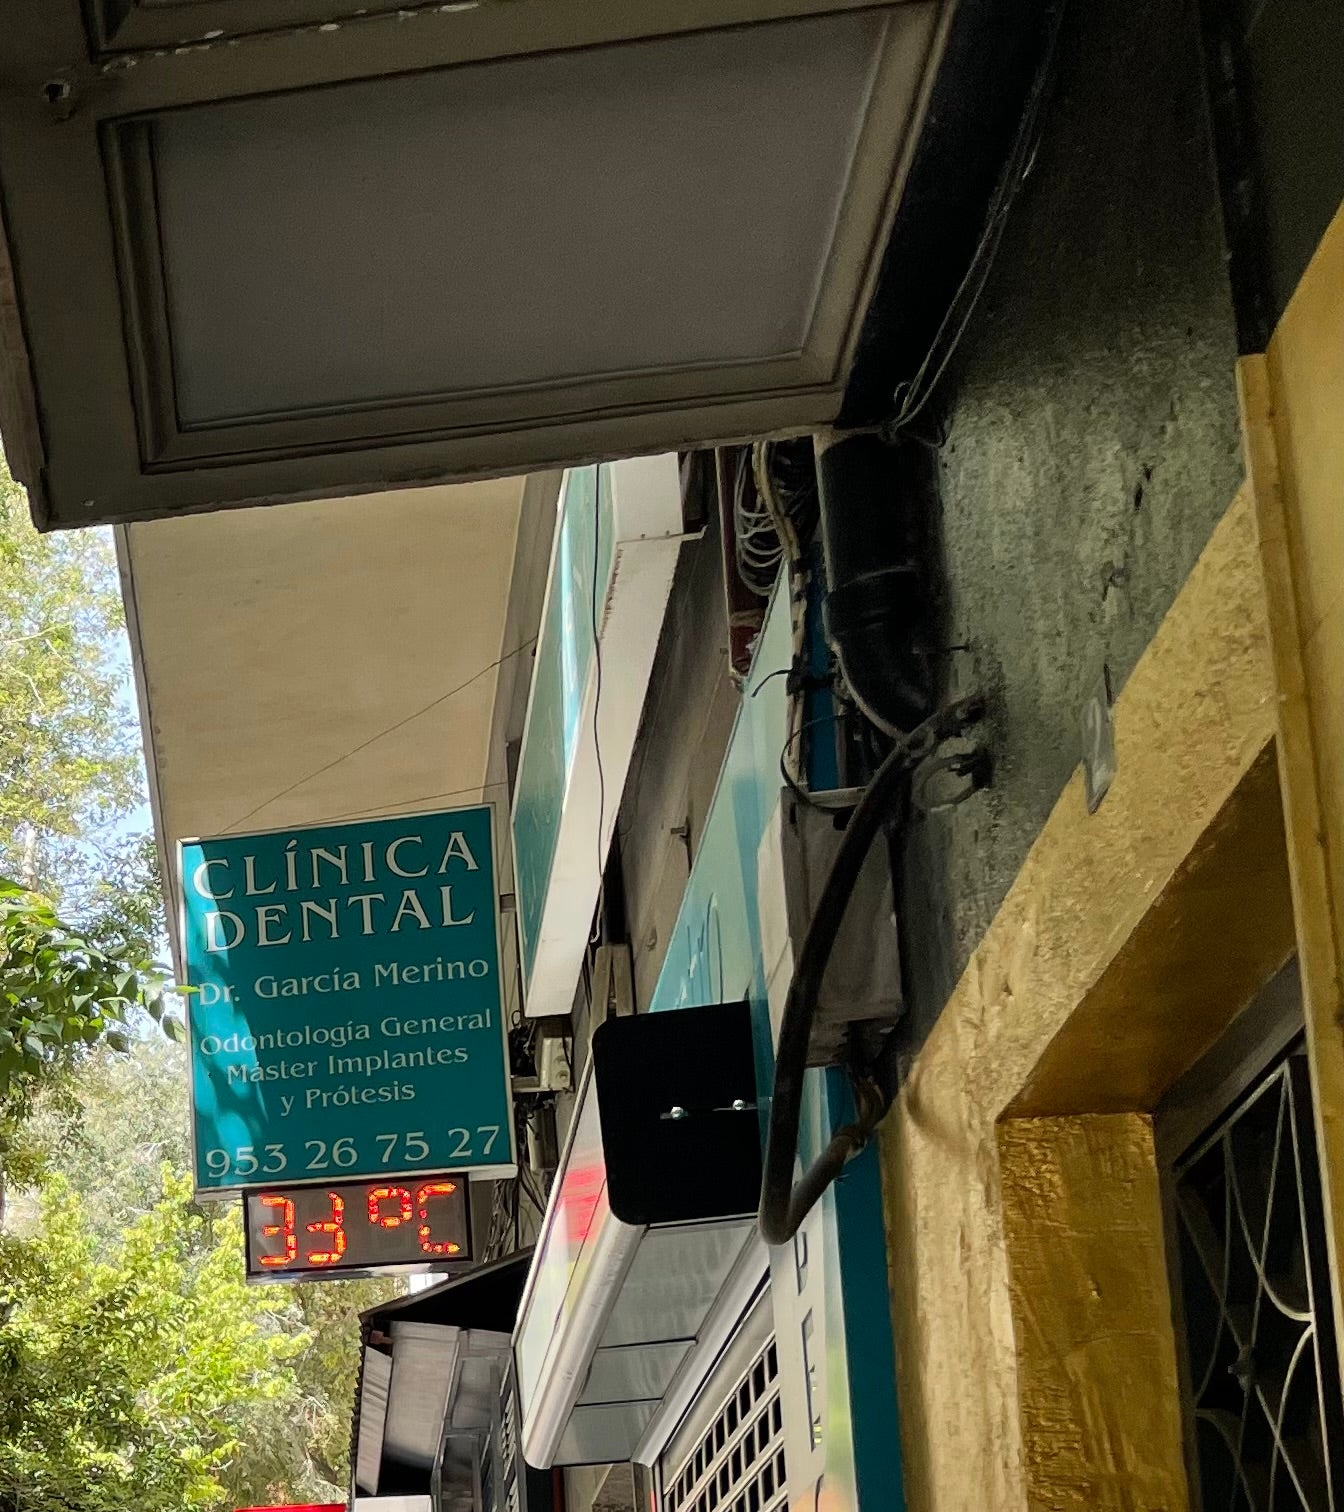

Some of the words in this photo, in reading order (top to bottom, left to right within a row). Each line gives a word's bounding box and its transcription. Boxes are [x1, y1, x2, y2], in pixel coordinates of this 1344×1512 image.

[193, 831, 480, 900] CLÍNICA
[203, 885, 474, 952] DENTAL
[198, 982, 240, 1007] Dr.
[254, 967, 362, 999] García
[374, 956, 489, 987] Merino
[200, 1019, 371, 1056] Odontología
[380, 1008, 492, 1038] General
[226, 1058, 318, 1085] Máster
[328, 1046, 469, 1077] Implantes
[280, 1095, 295, 1117] y
[305, 1080, 416, 1110] Prótesis
[206, 1143, 288, 1179] 953
[305, 1137, 358, 1170] 26
[375, 1131, 430, 1162] 75
[447, 1125, 500, 1158] 27
